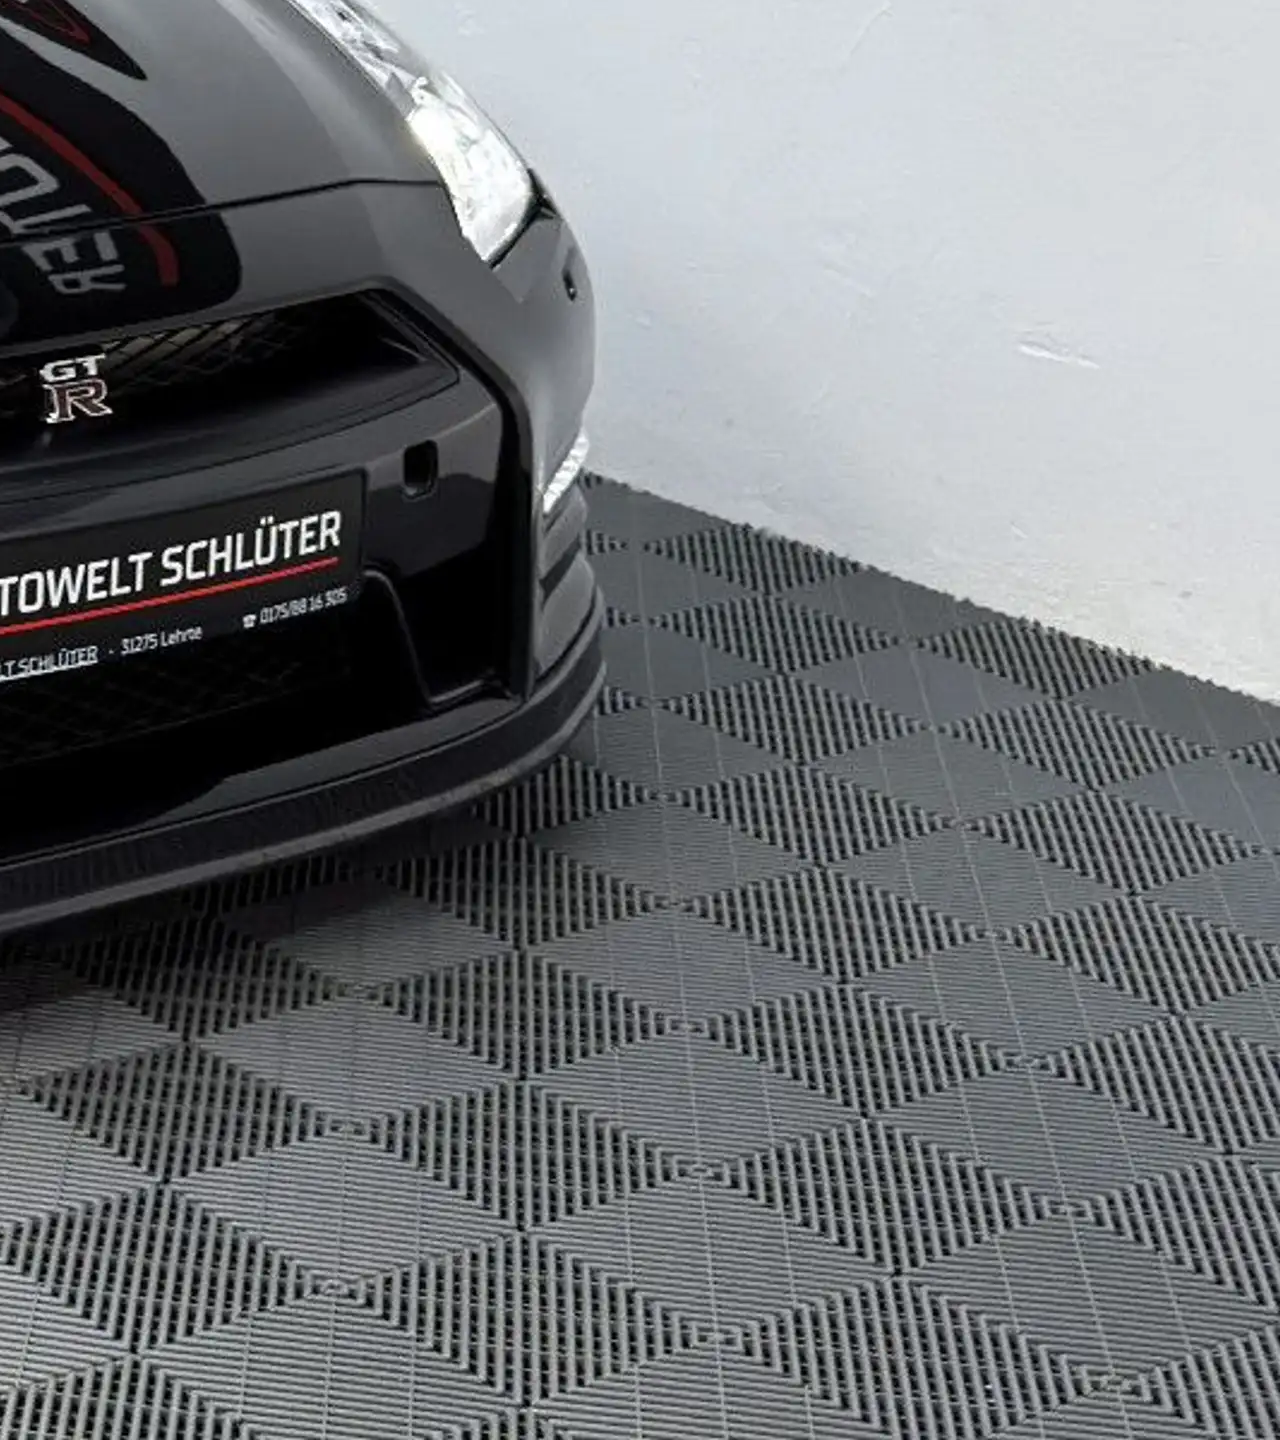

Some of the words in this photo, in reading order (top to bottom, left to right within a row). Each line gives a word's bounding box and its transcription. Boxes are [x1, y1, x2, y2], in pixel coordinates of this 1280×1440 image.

[39, 353, 106, 382] GT
[42, 378, 113, 424] R
[160, 509, 342, 588] SCHLÜTER
[18, 645, 99, 677] SCHLÜTER
